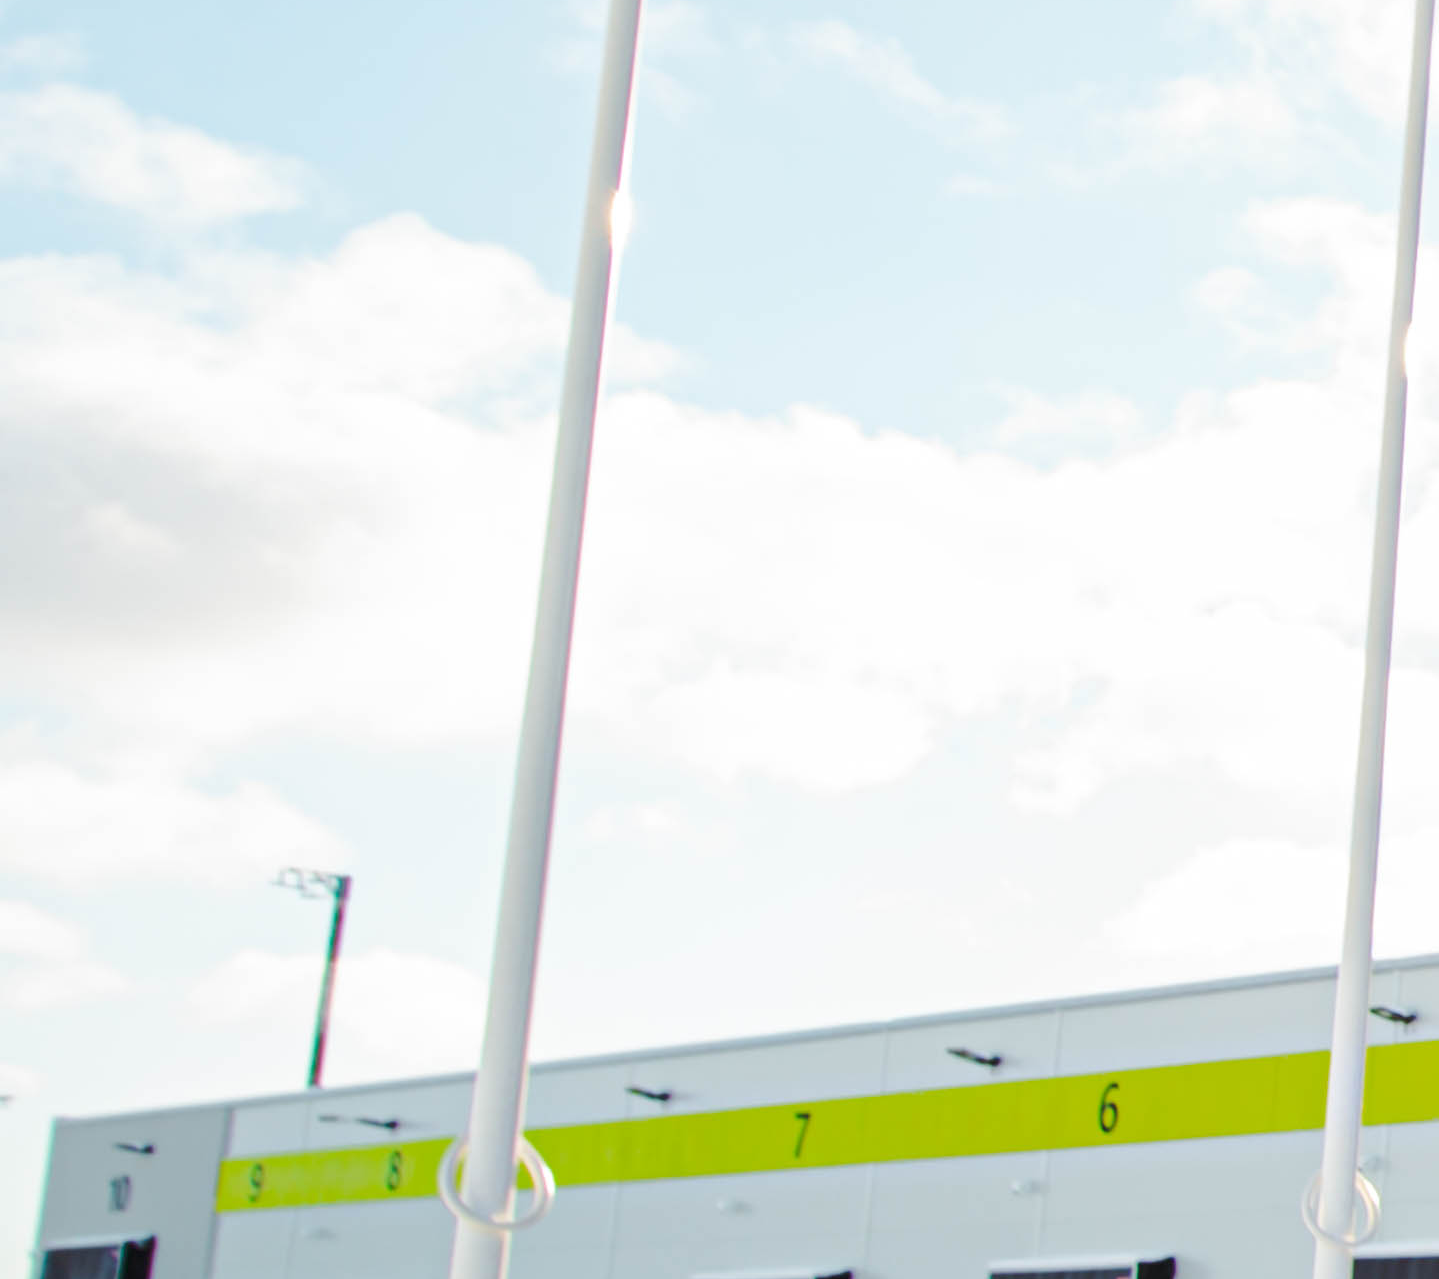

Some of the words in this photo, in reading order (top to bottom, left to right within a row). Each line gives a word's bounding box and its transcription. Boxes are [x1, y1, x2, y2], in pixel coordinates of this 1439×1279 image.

[1098, 1082, 1120, 1133] 6
[794, 1112, 812, 1159] 7
[248, 1163, 264, 1203] 9
[386, 1150, 403, 1191] 8
[109, 1175, 132, 1212] 10
